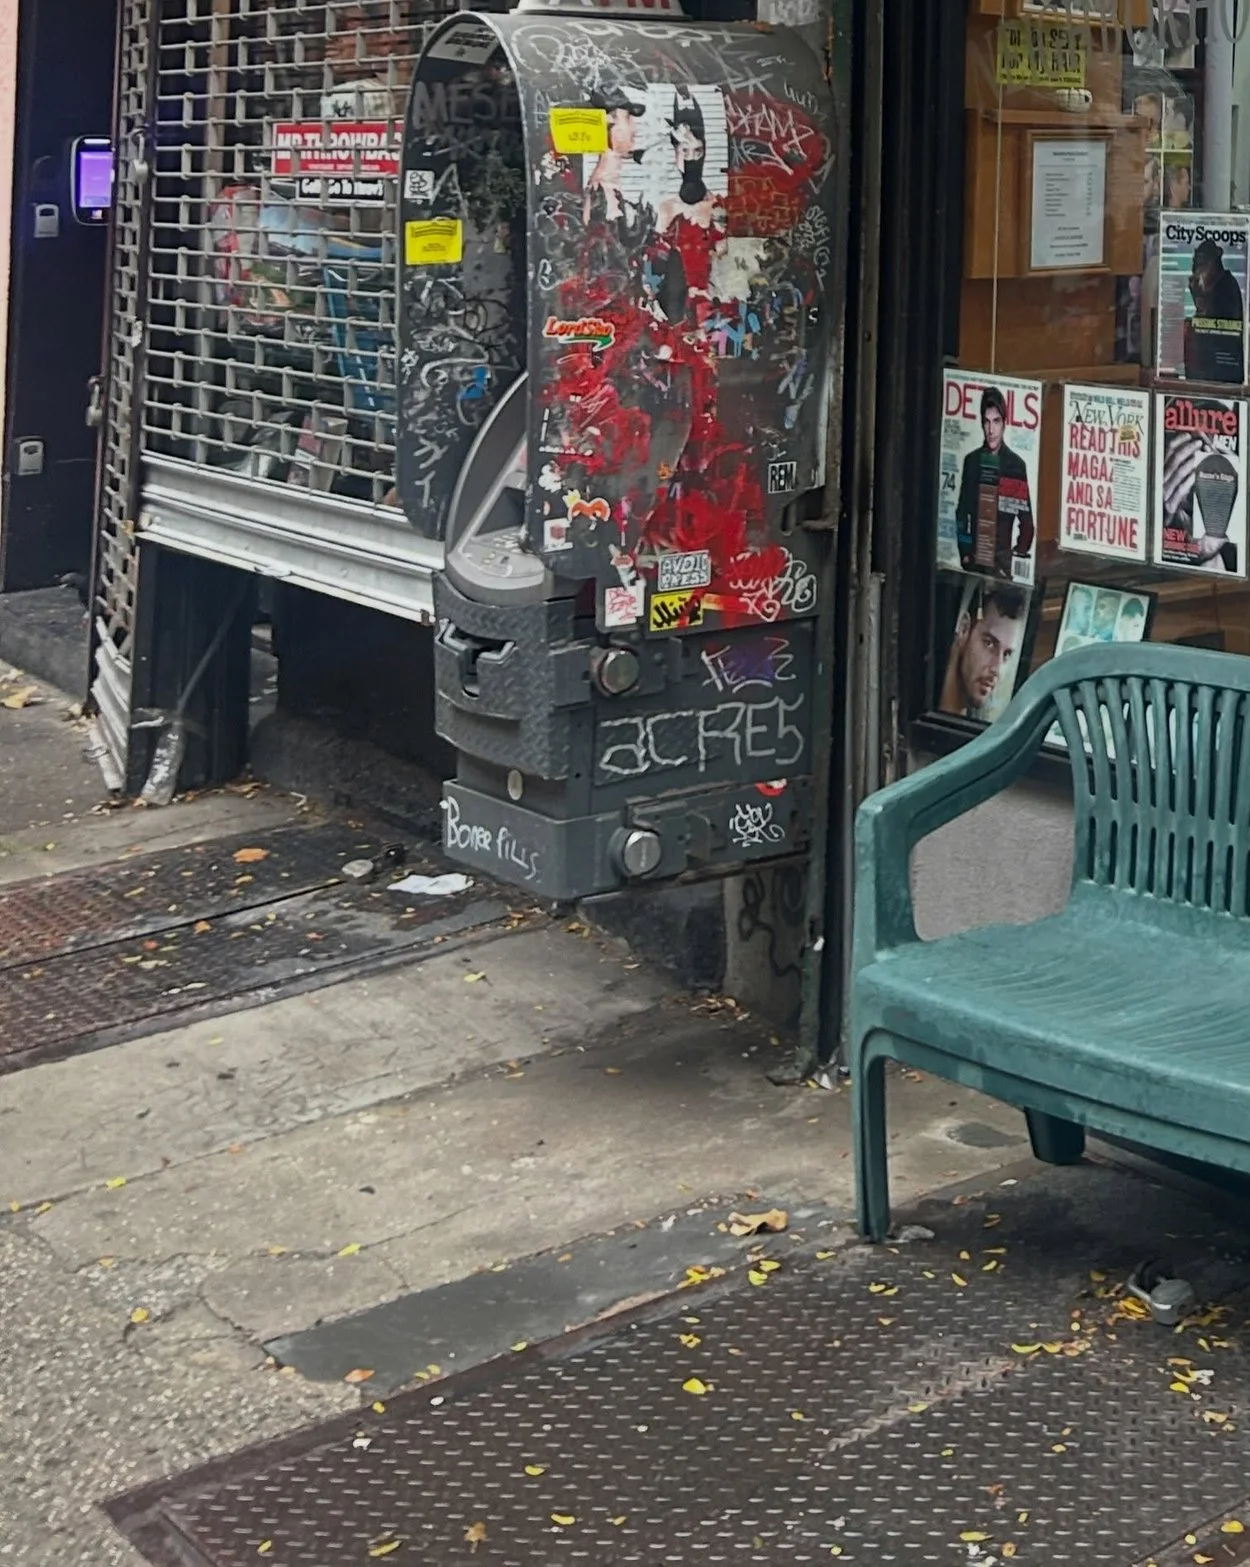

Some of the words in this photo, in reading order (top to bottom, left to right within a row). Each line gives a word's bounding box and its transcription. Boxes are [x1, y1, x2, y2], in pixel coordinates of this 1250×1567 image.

[1165, 399, 1237, 435] allure
[1070, 423, 1107, 453] READ
[1212, 434, 1237, 451] MEN
[942, 471, 956, 491] 74
[1066, 482, 1093, 509] AND
[1066, 507, 1139, 549] FORTUNE
